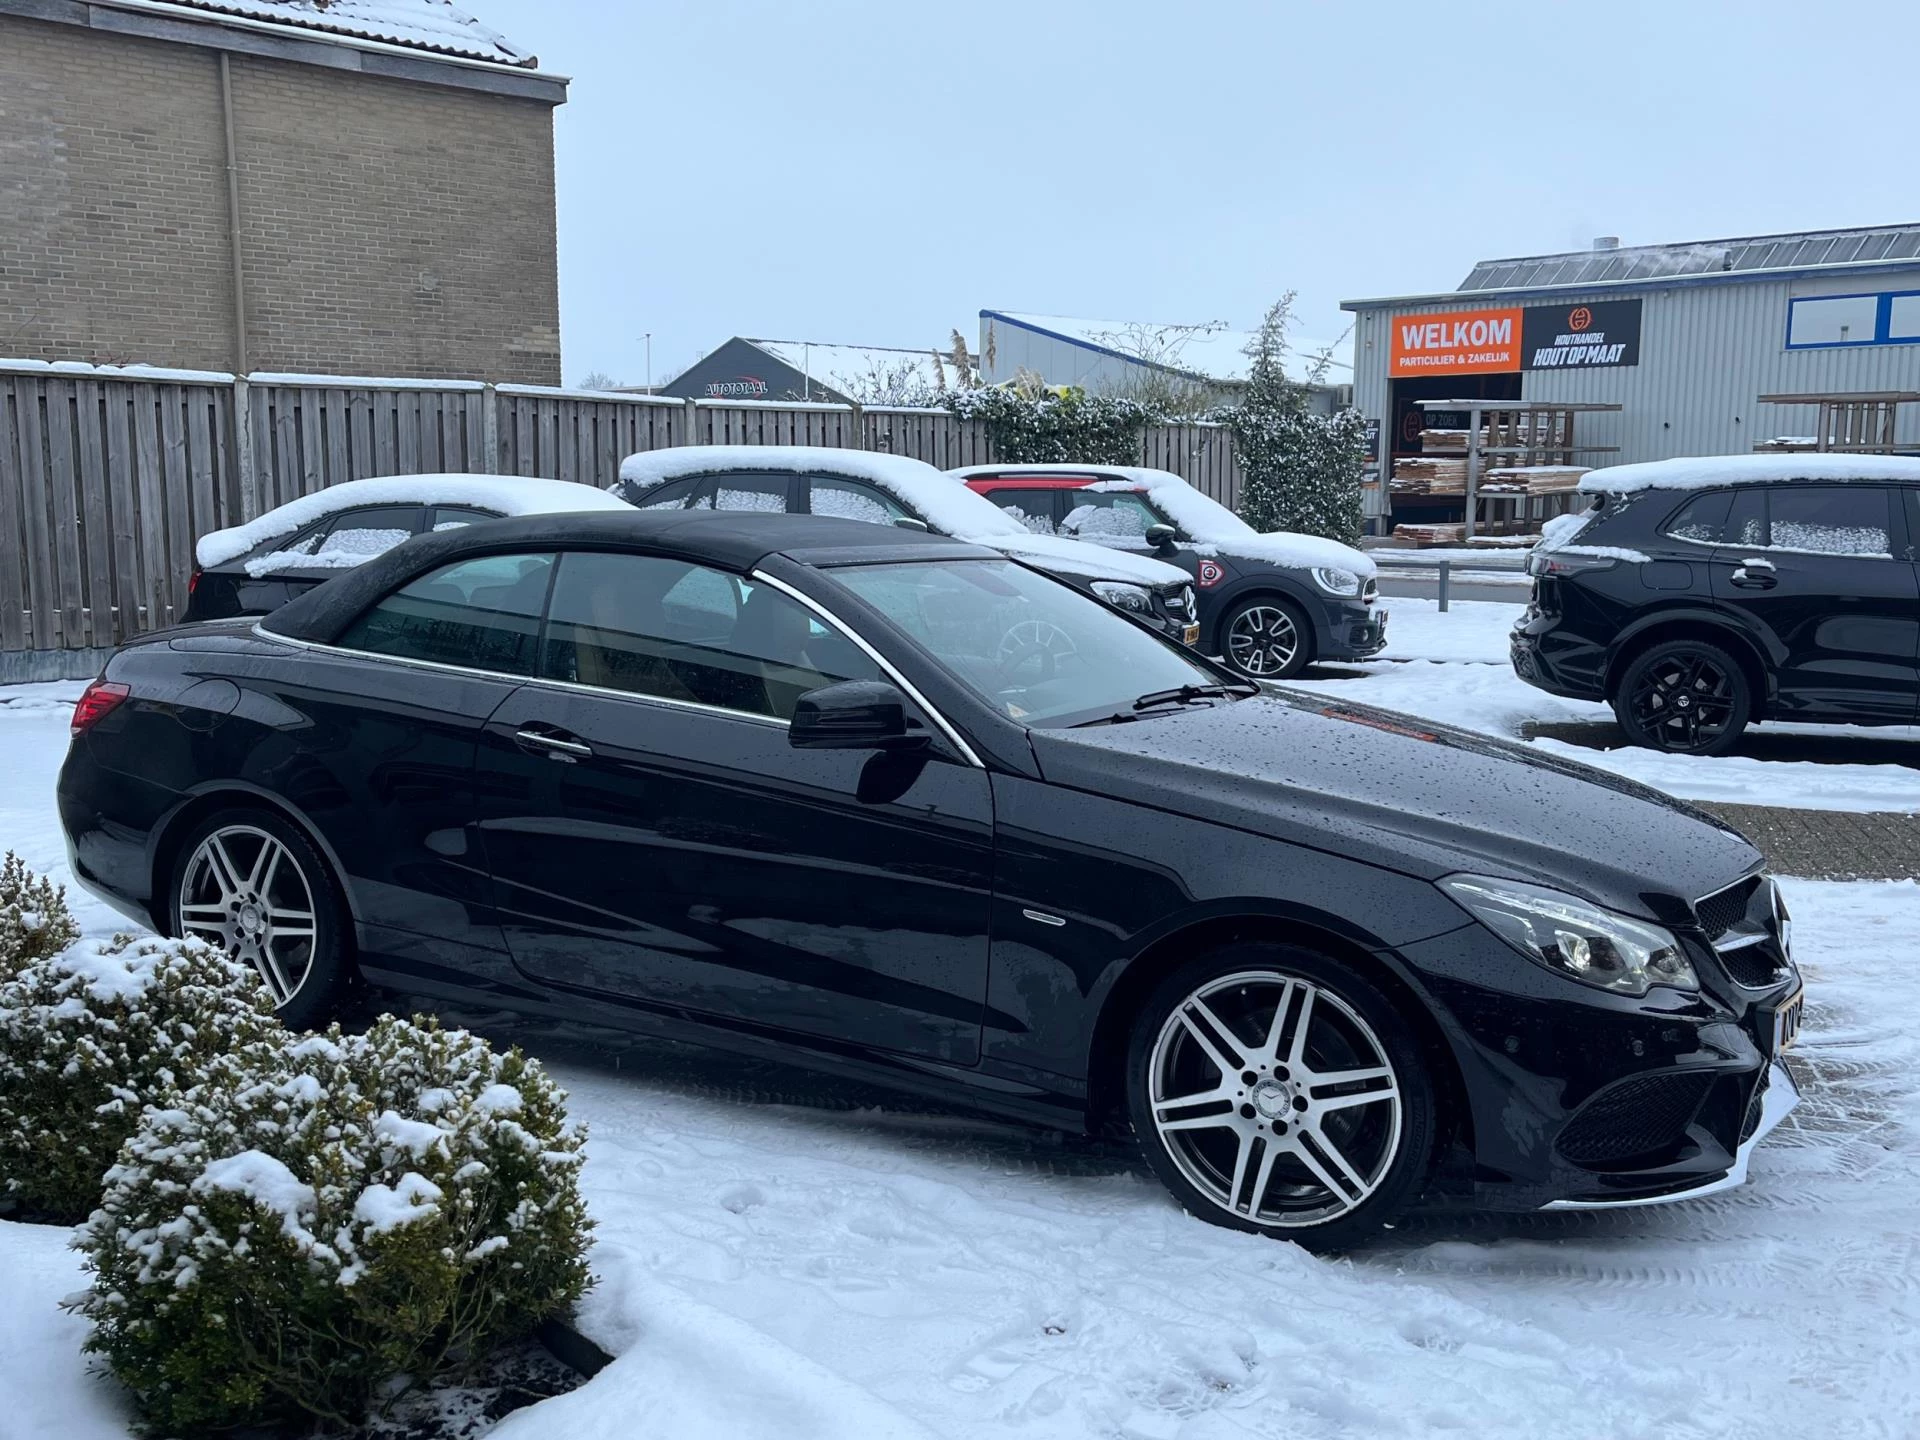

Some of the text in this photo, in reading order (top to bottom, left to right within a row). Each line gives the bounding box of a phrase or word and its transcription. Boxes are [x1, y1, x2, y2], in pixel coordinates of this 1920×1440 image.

[1402, 319, 1511, 350] WELKOM
[1554, 333, 1604, 346] HOUTHANDEL
[1400, 352, 1510, 367] PARTICULIER & ZAKELIJK
[1532, 348, 1569, 366] HOUT
[1584, 344, 1626, 364] MAAT
[705, 381, 769, 396] AUTOTOTAAL
[1425, 414, 1457, 426] OP ZOEK
